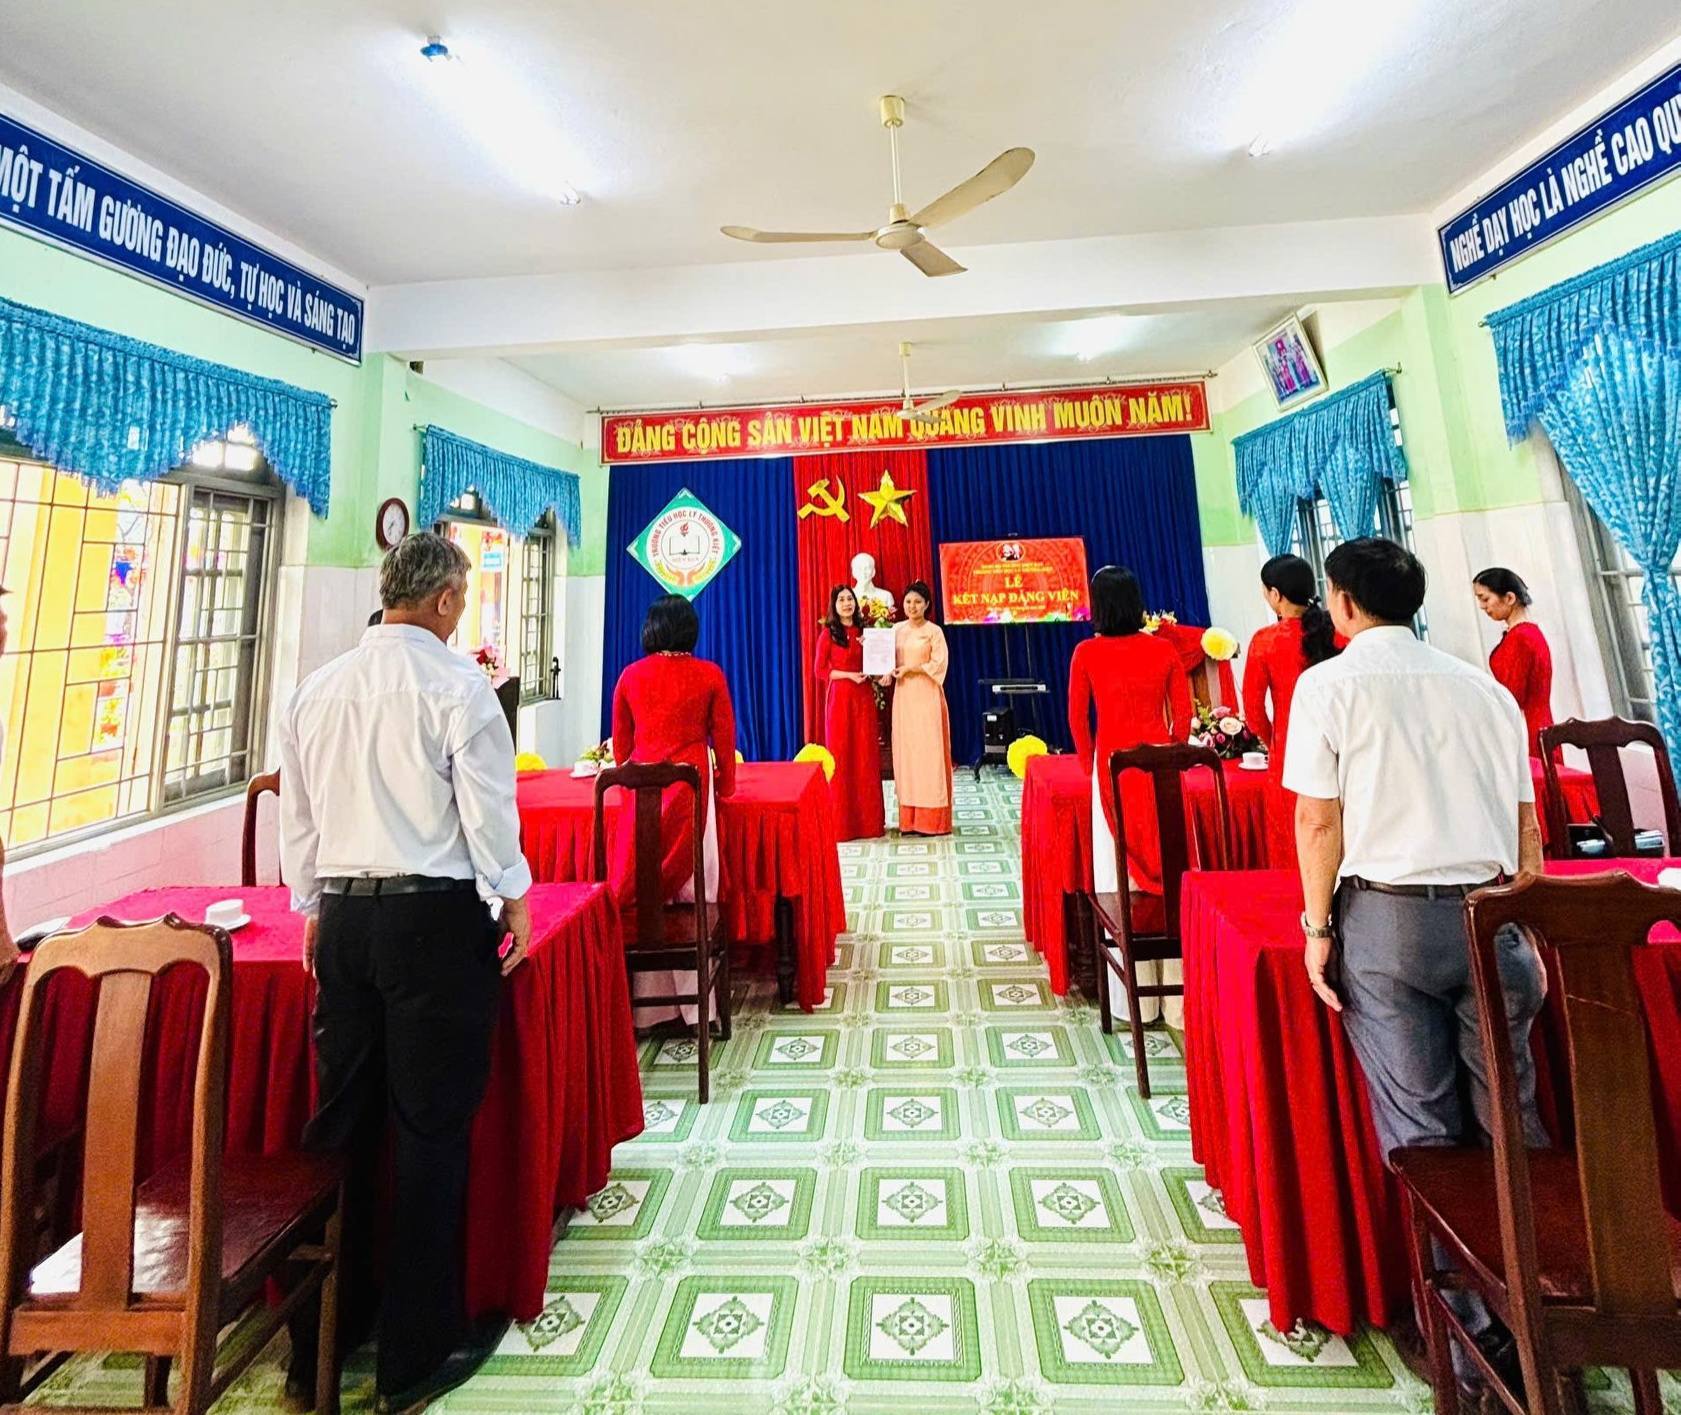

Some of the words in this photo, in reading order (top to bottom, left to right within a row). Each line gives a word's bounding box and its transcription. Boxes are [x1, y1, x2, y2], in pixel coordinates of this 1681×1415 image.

[47, 165, 96, 232] TẤM
[99, 195, 163, 262] GƯƠNG
[166, 226, 201, 283] ĐẠO
[202, 241, 235, 299] ĐỨC,
[240, 260, 260, 311] TỰ
[257, 271, 285, 319] HỌC
[287, 281, 302, 321] VÀ
[304, 289, 335, 337] SÁNG
[336, 307, 356, 350] TẠO
[1450, 212, 1484, 273] NGHỀ
[1482, 206, 1510, 256] DẠY
[1508, 188, 1541, 240] HỌC
[1539, 167, 1565, 219] LÀ
[1561, 129, 1613, 206] NGHỀ
[1611, 116, 1654, 176] CAO
[616, 418, 676, 453] ĐẢNG
[682, 416, 741, 455] CỘNG
[747, 411, 793, 447] SẢN
[798, 411, 845, 448] VIỆT
[850, 413, 904, 441] NAM
[990, 402, 1047, 433] VINH
[1053, 395, 1123, 430] MUÔN
[1129, 391, 1193, 424] NĂM!
